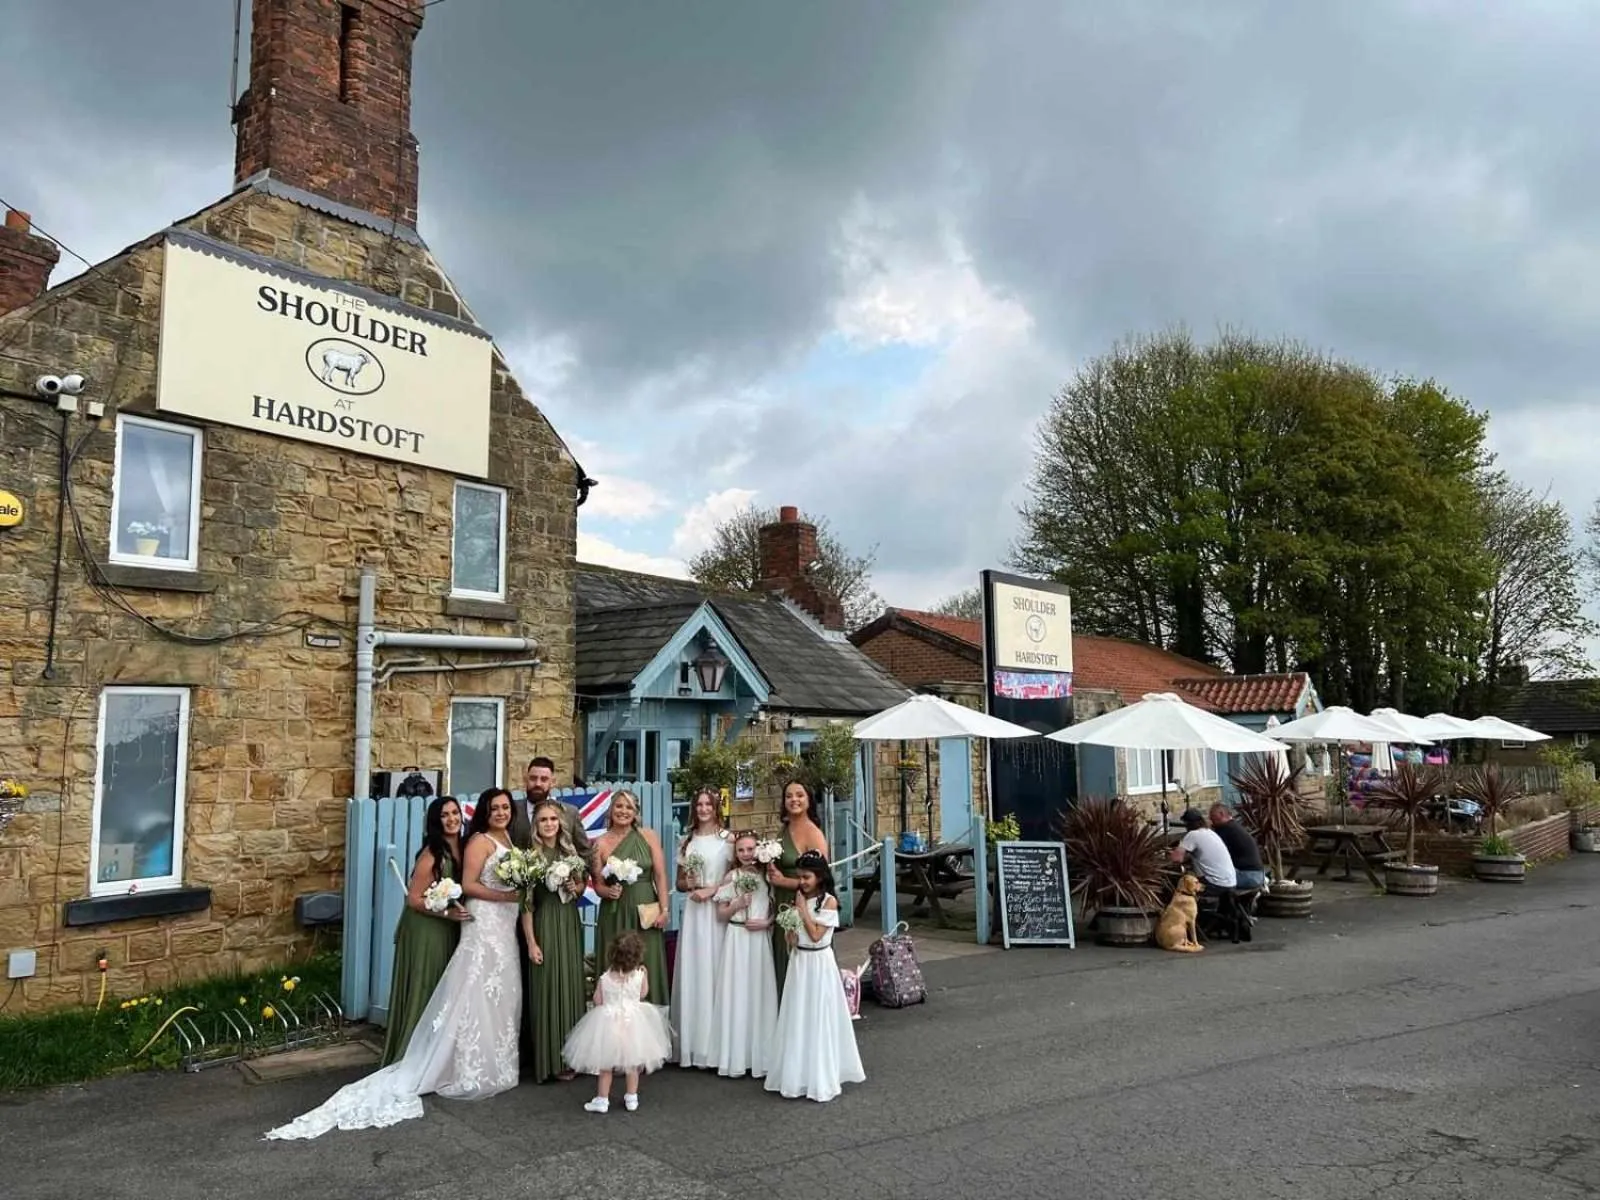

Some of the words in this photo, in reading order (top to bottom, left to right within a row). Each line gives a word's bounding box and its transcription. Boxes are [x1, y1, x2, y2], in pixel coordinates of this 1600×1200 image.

[334, 292, 366, 311] THE
[257, 286, 427, 356] SHOULDER
[334, 399, 354, 411] AT
[252, 395, 424, 453] HARDSTOFT
[1013, 597, 1056, 616] SHOULDER
[1015, 651, 1058, 666] HARDSTOFT
